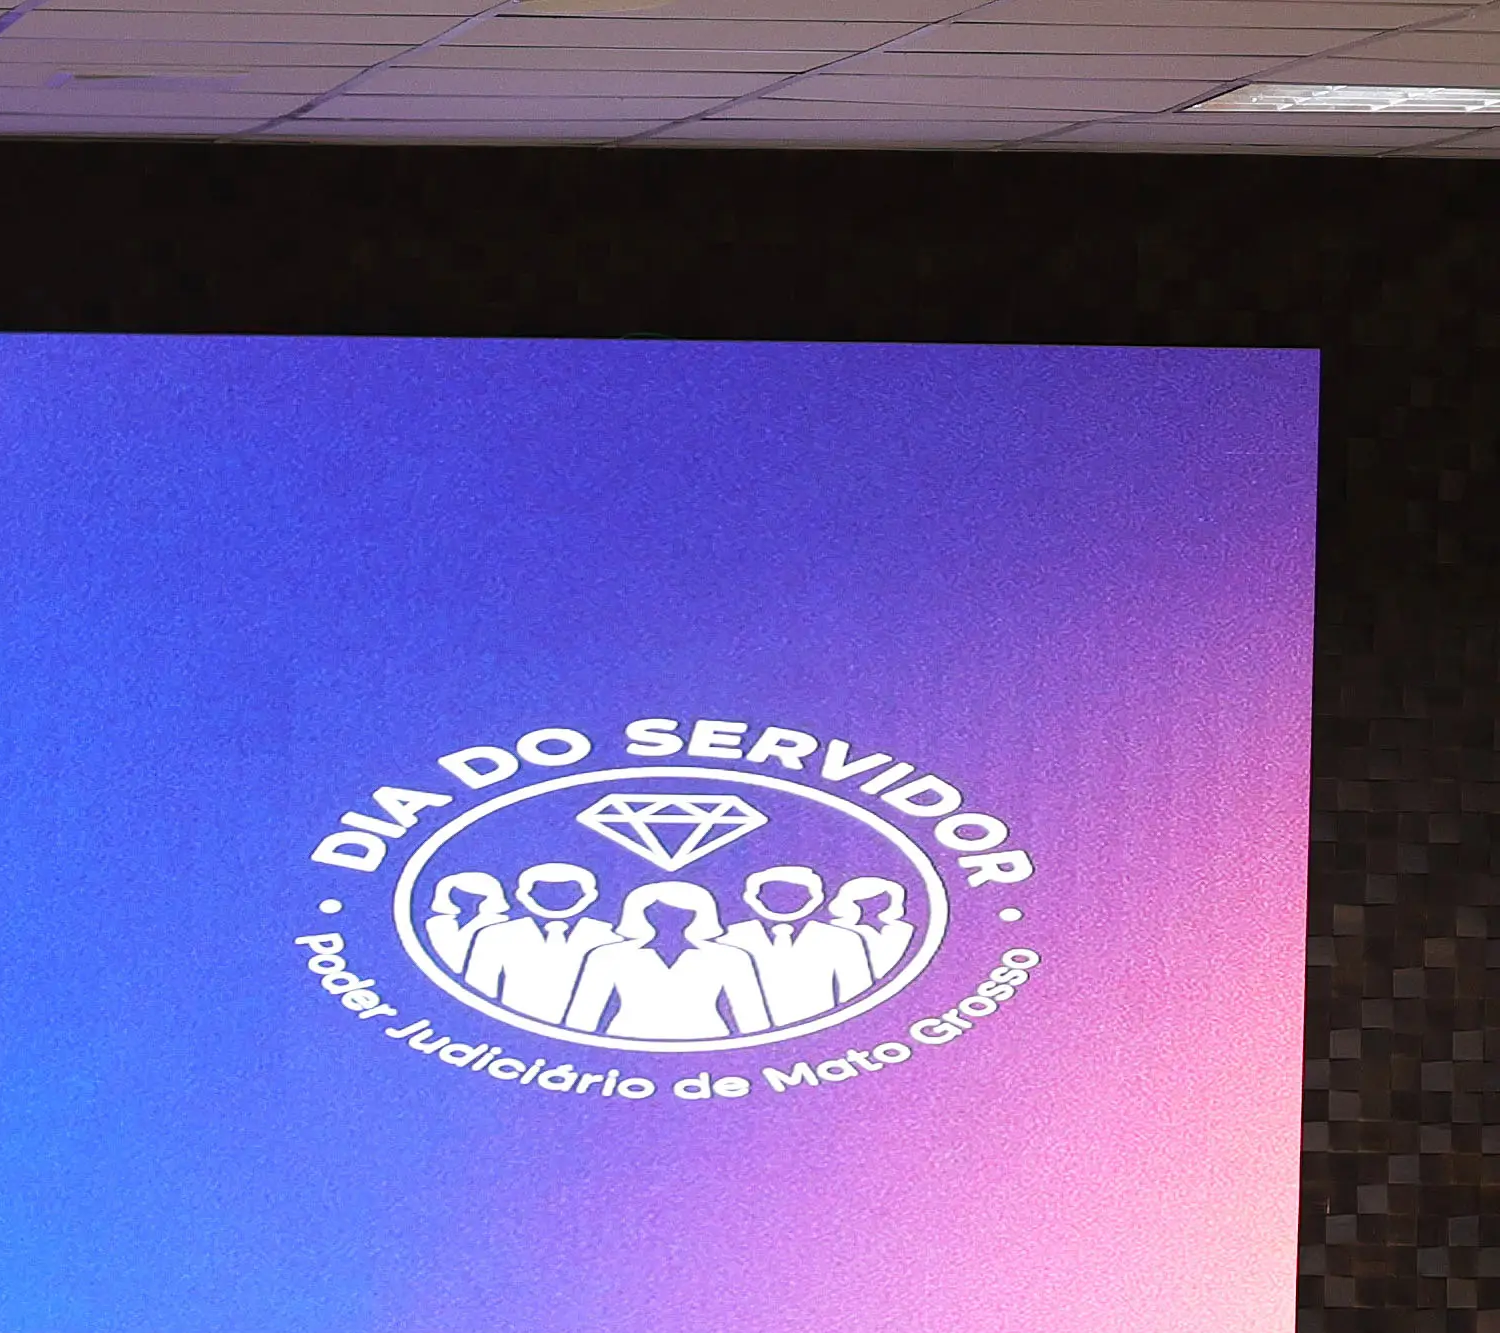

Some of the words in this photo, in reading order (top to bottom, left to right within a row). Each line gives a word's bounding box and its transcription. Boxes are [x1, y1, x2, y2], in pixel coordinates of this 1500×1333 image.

[310, 786, 453, 872] DIA
[437, 728, 591, 790] DO
[625, 718, 1034, 888] SERVIDOR
[294, 932, 398, 1020] Poder
[384, 1019, 655, 1099] Judiciário
[673, 1068, 751, 1100] de
[762, 1041, 912, 1093] Mato
[908, 947, 1041, 1045] Grosso
